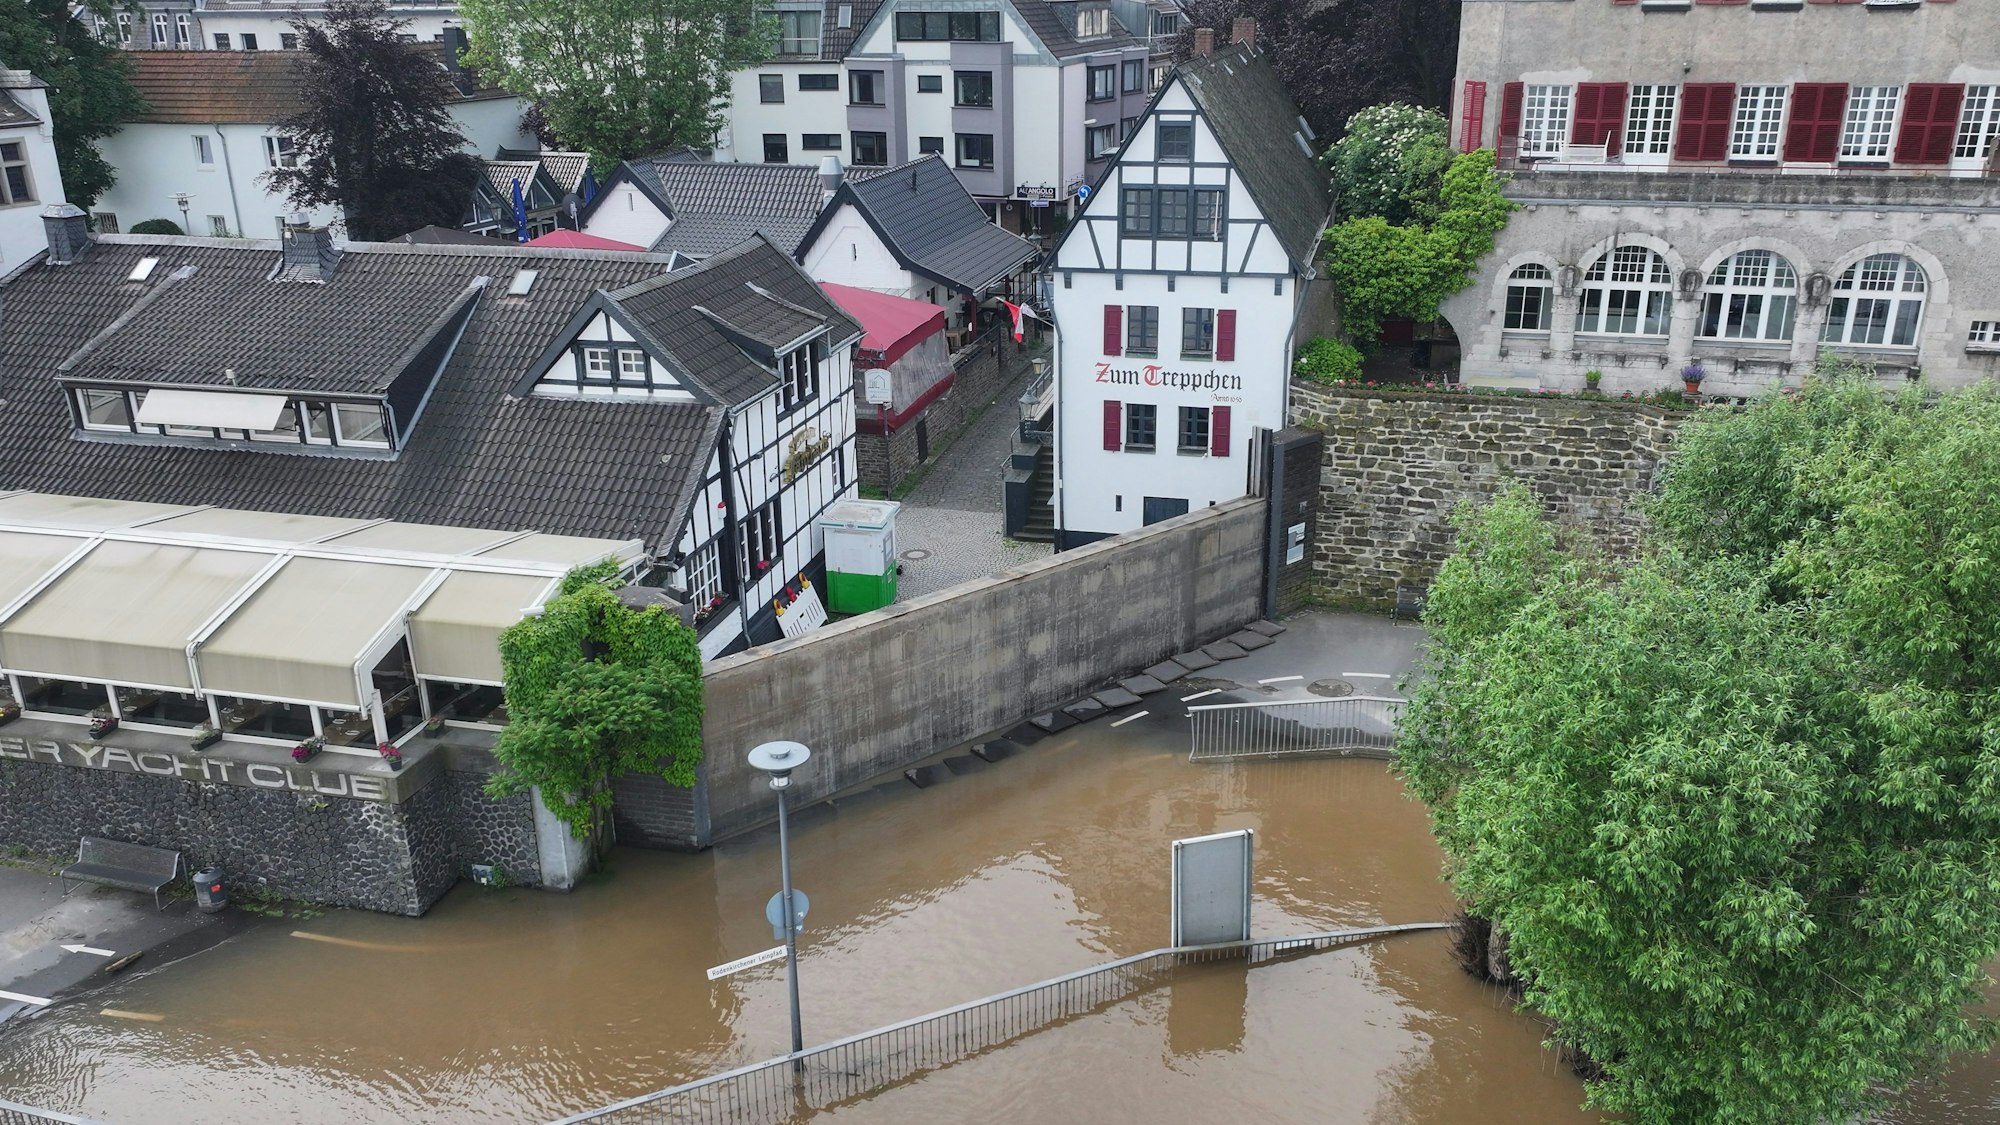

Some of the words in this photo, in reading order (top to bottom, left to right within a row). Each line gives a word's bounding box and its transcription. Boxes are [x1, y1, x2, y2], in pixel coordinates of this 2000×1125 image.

[1094, 362, 1140, 385] Zum
[1142, 364, 1242, 392] Treppchen
[68, 743, 234, 782] YACHT
[246, 763, 388, 800] CLUB
[711, 958, 756, 977] Rodenkirchener
[758, 950, 783, 962] Leinpfad
